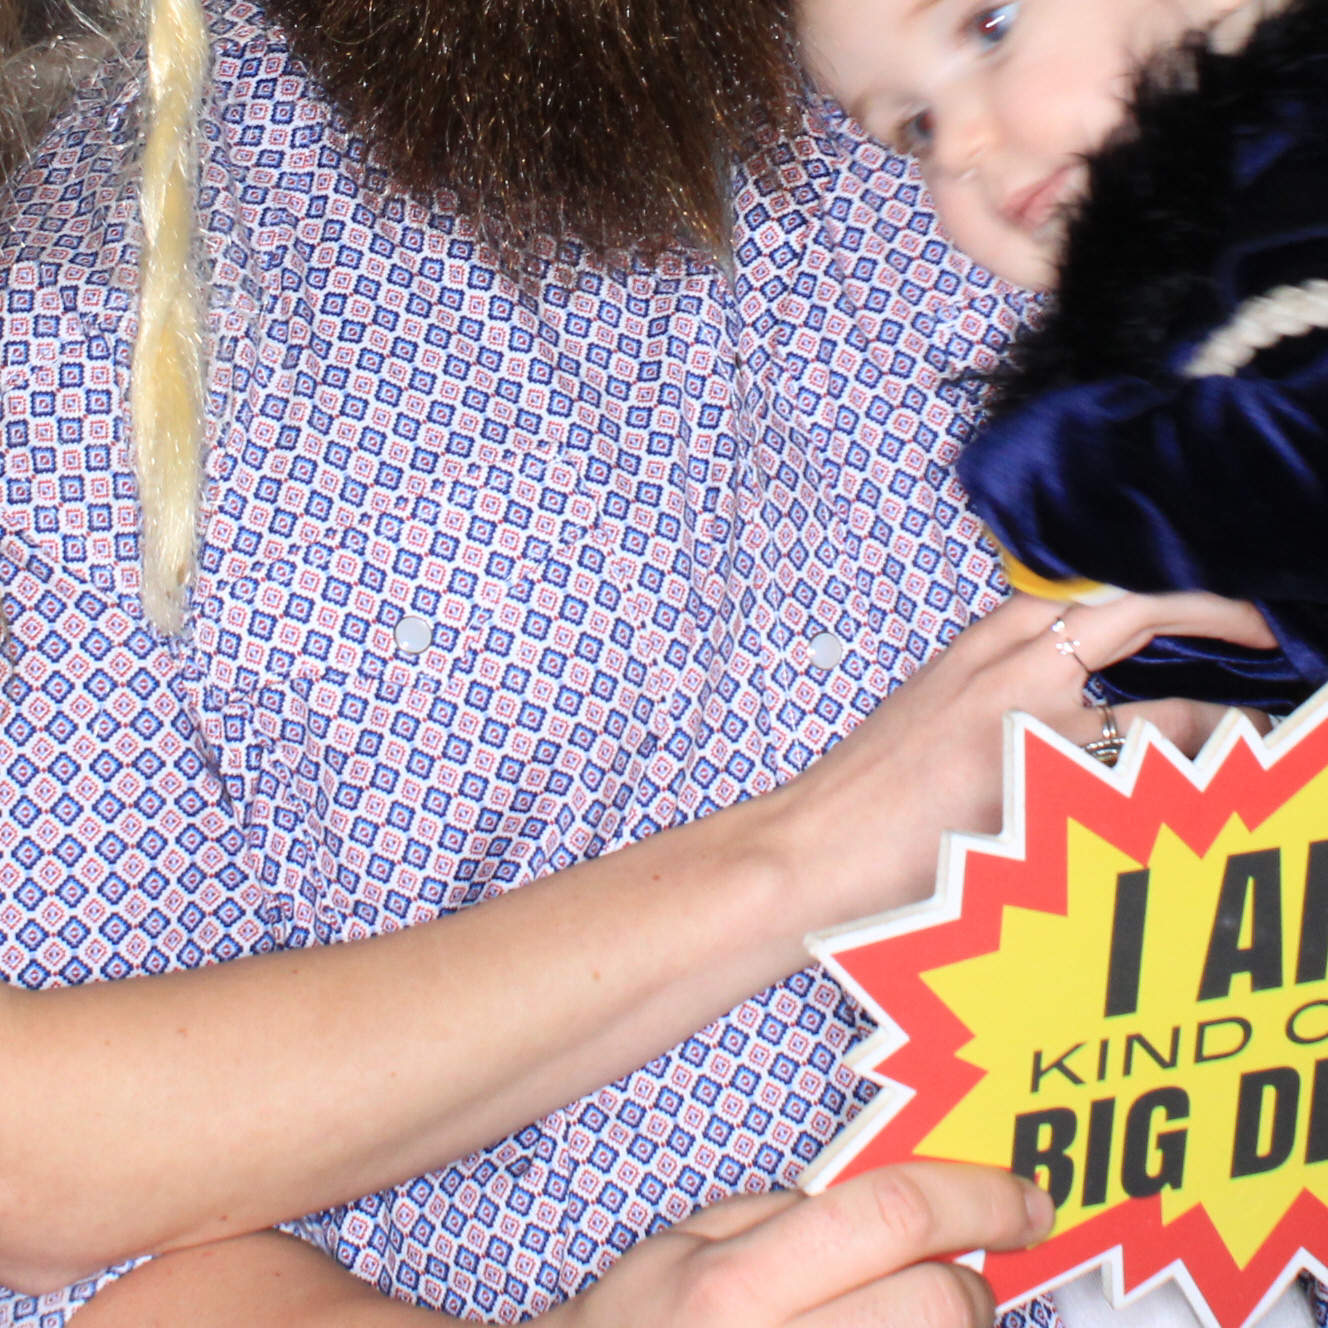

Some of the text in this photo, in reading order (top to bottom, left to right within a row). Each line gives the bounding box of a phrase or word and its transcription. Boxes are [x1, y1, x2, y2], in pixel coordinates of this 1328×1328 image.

[1104, 869, 1151, 1018] I
[1030, 1016, 1253, 1093] KIND
[1012, 1086, 1191, 1212] BIG
